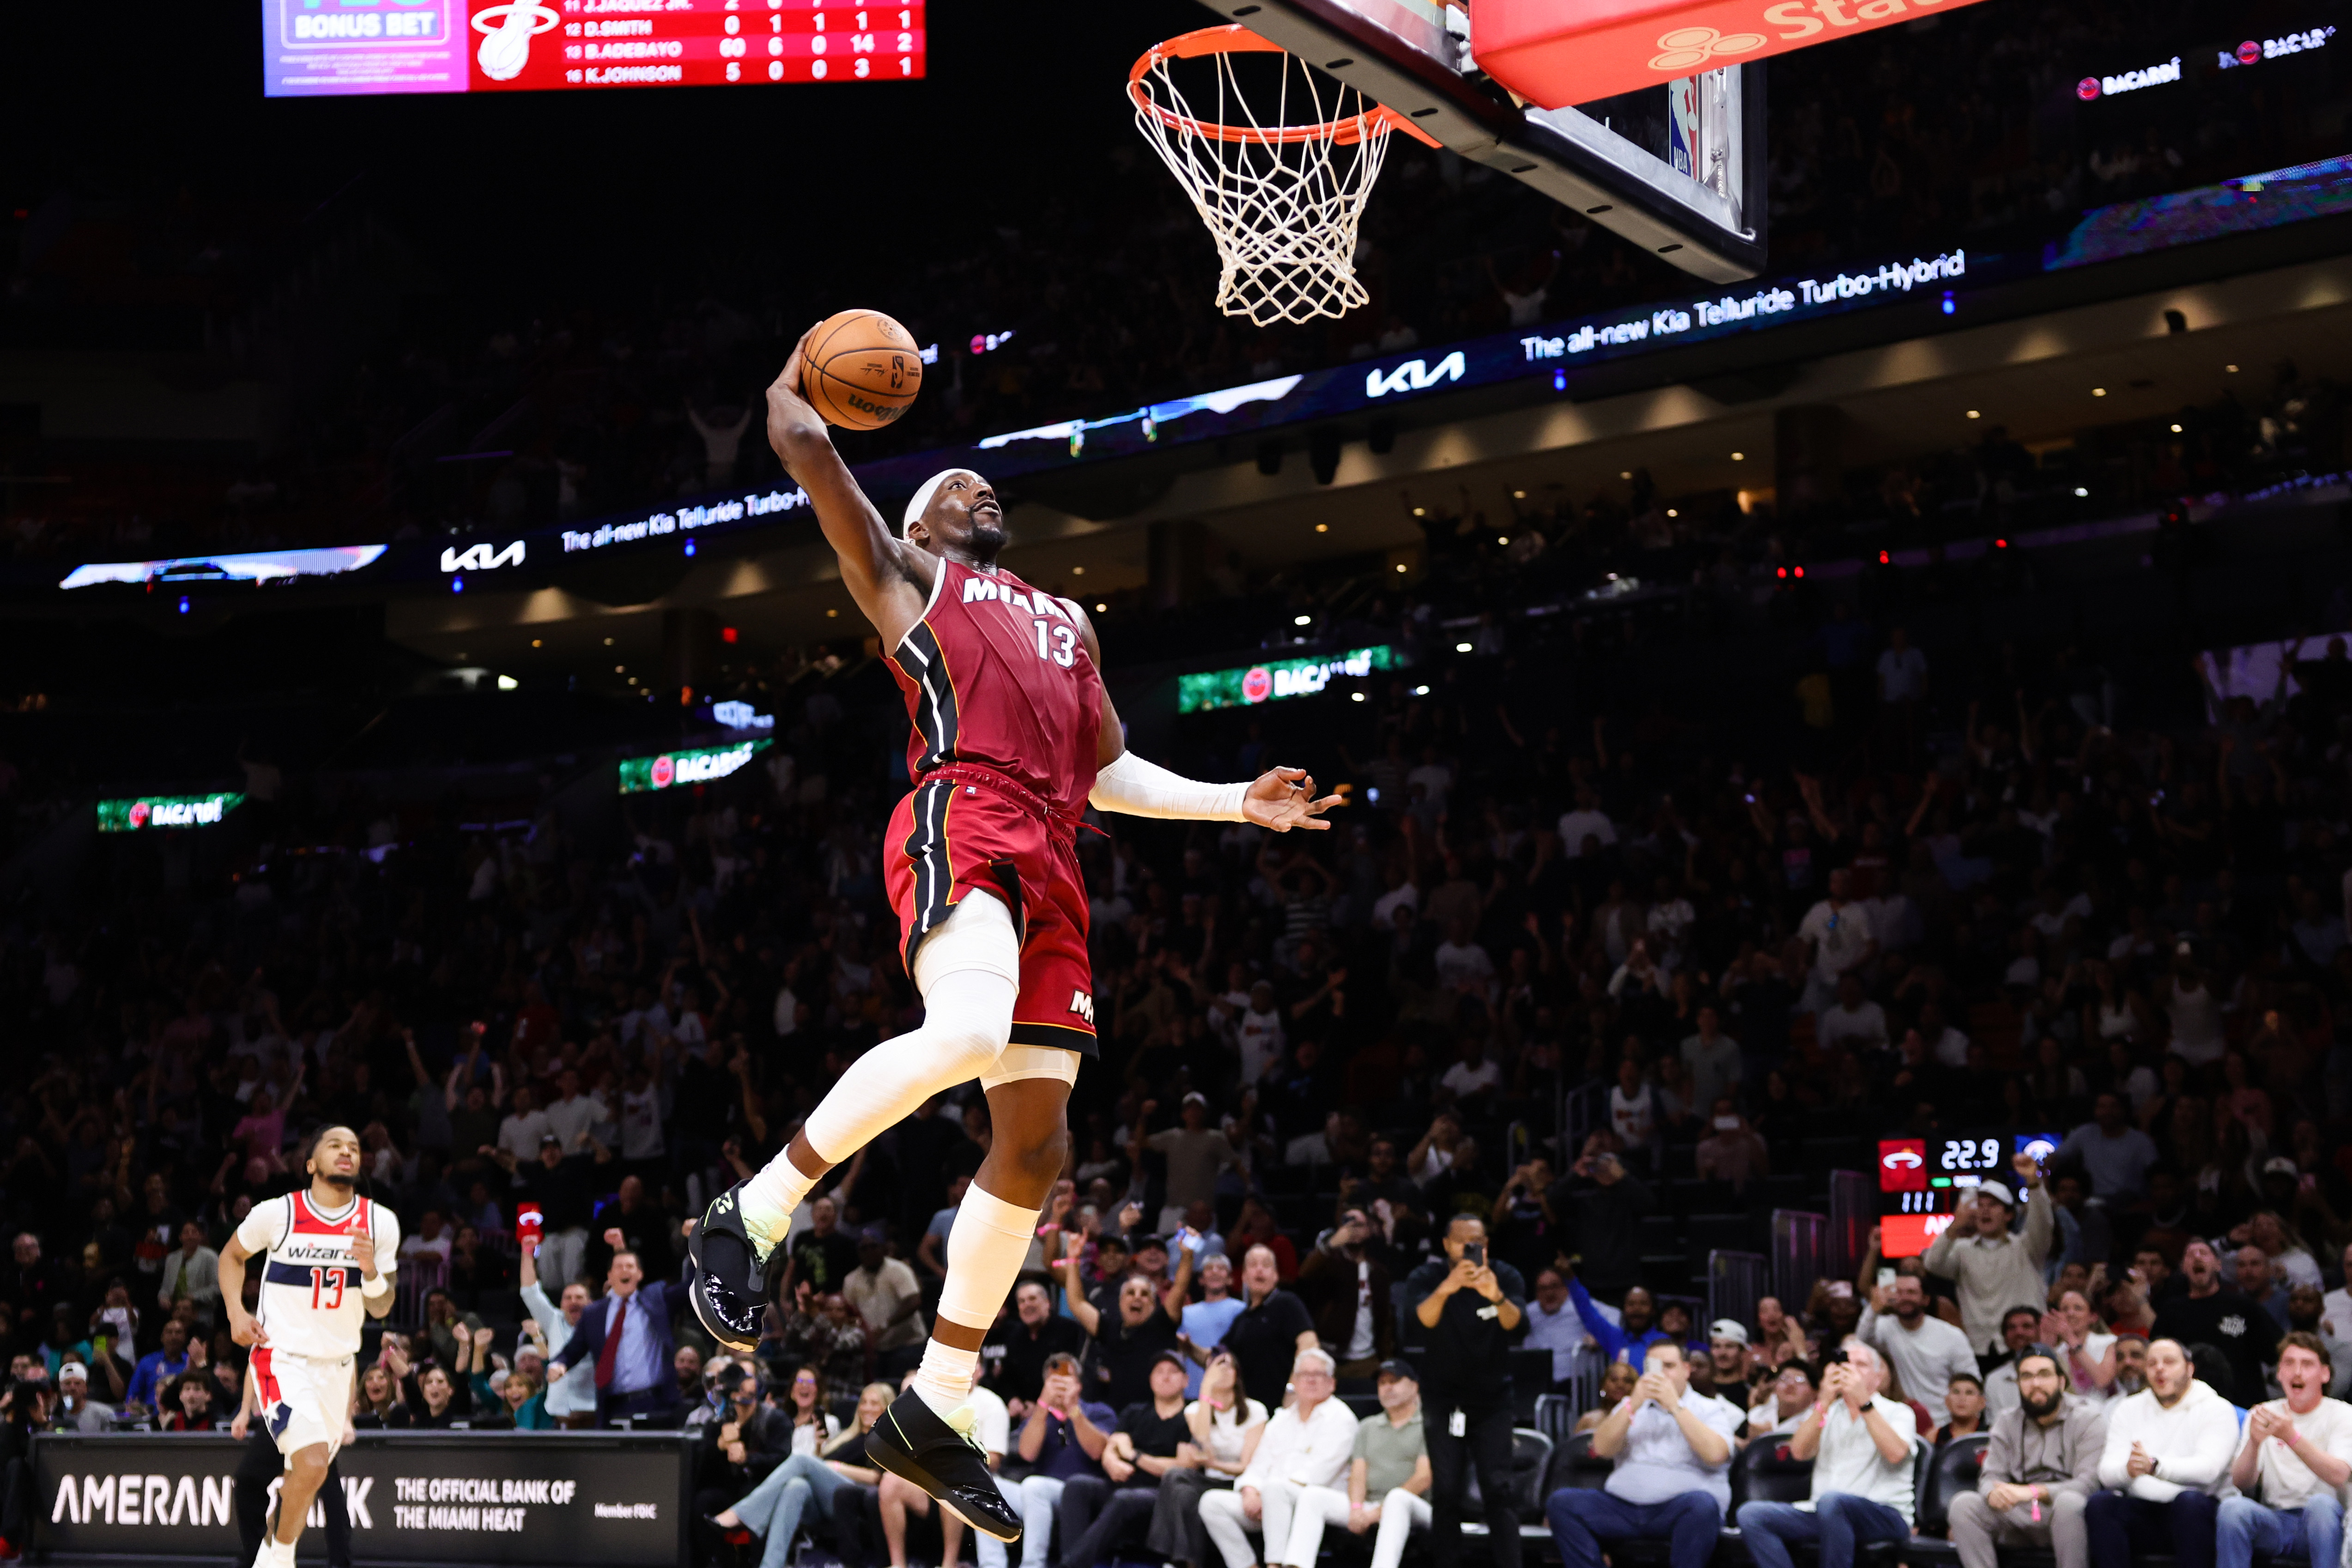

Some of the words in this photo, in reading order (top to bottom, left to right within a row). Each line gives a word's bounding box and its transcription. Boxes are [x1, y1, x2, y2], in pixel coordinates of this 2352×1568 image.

[295, 13, 382, 38] BONUS
[386, 11, 436, 36] BET
[564, 22, 582, 36] 12
[584, 19, 653, 37] D.SMITH
[724, 15, 740, 35] 0
[769, 14, 782, 33] 1
[812, 12, 825, 32] 1
[855, 11, 867, 30] 1
[898, 10, 910, 29] 1
[1763, 0, 1942, 39] Sta
[585, 41, 683, 60] B.ADEBAYO
[719, 37, 746, 58] 60
[768, 36, 783, 56] 6
[811, 35, 827, 55] 0
[850, 33, 876, 53] 14
[897, 32, 913, 52] 2
[585, 65, 682, 84] K.JOHNSON
[726, 61, 741, 82] 5
[768, 60, 784, 80] 0
[812, 59, 827, 79] 0
[855, 58, 870, 78] 3
[899, 56, 911, 76] 1
[1520, 336, 1565, 362] The
[1567, 318, 1651, 355] all-new
[1652, 308, 1691, 336] Kia
[1693, 287, 1795, 327] Telluride
[1797, 249, 1965, 306] Turbo-Hybrid
[562, 531, 592, 552] The
[592, 520, 649, 547] all-new
[649, 512, 676, 538] Kia
[677, 499, 743, 530] Telluride
[1033, 618, 1076, 669] 13
[1941, 1138, 2000, 1170] 22.9
[1901, 1191, 1934, 1213] 111
[288, 1241, 358, 1259] wizar
[310, 1266, 348, 1310] 13
[51, 1474, 235, 1526] AMERAN
[394, 1477, 428, 1502] THE
[429, 1478, 500, 1503] OFFICIAL
[501, 1478, 550, 1504] BANK
[550, 1479, 576, 1505] OF
[394, 1504, 427, 1529] THE
[428, 1506, 480, 1531] MIAMI
[481, 1507, 527, 1532] HEAT
[594, 1502, 633, 1519] Member
